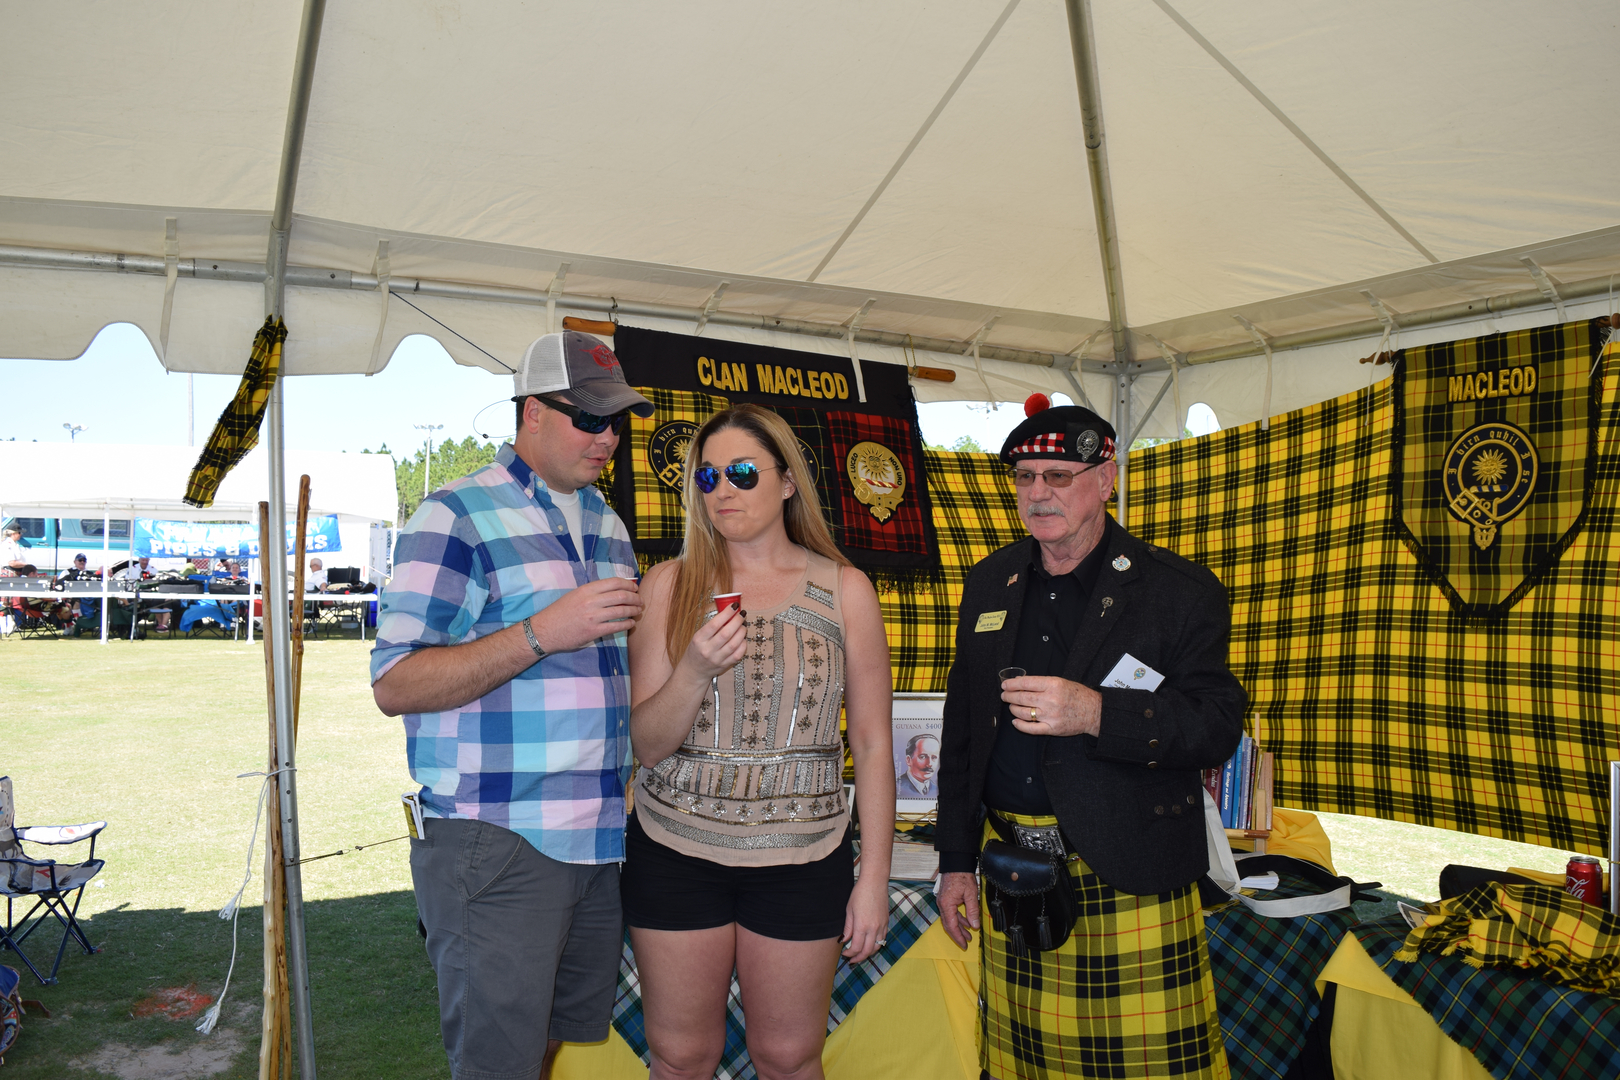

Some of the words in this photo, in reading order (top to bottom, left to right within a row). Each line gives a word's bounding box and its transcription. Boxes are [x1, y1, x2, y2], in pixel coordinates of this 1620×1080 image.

[696, 356, 749, 392] CLAN
[756, 363, 850, 400] MACLEOD
[1448, 365, 1537, 402] MACLEOD
[850, 452, 859, 473] LUCEO
[888, 456, 900, 471] NON
[149, 538, 217, 556] PIPES
[925, 722, 942, 730] $400
